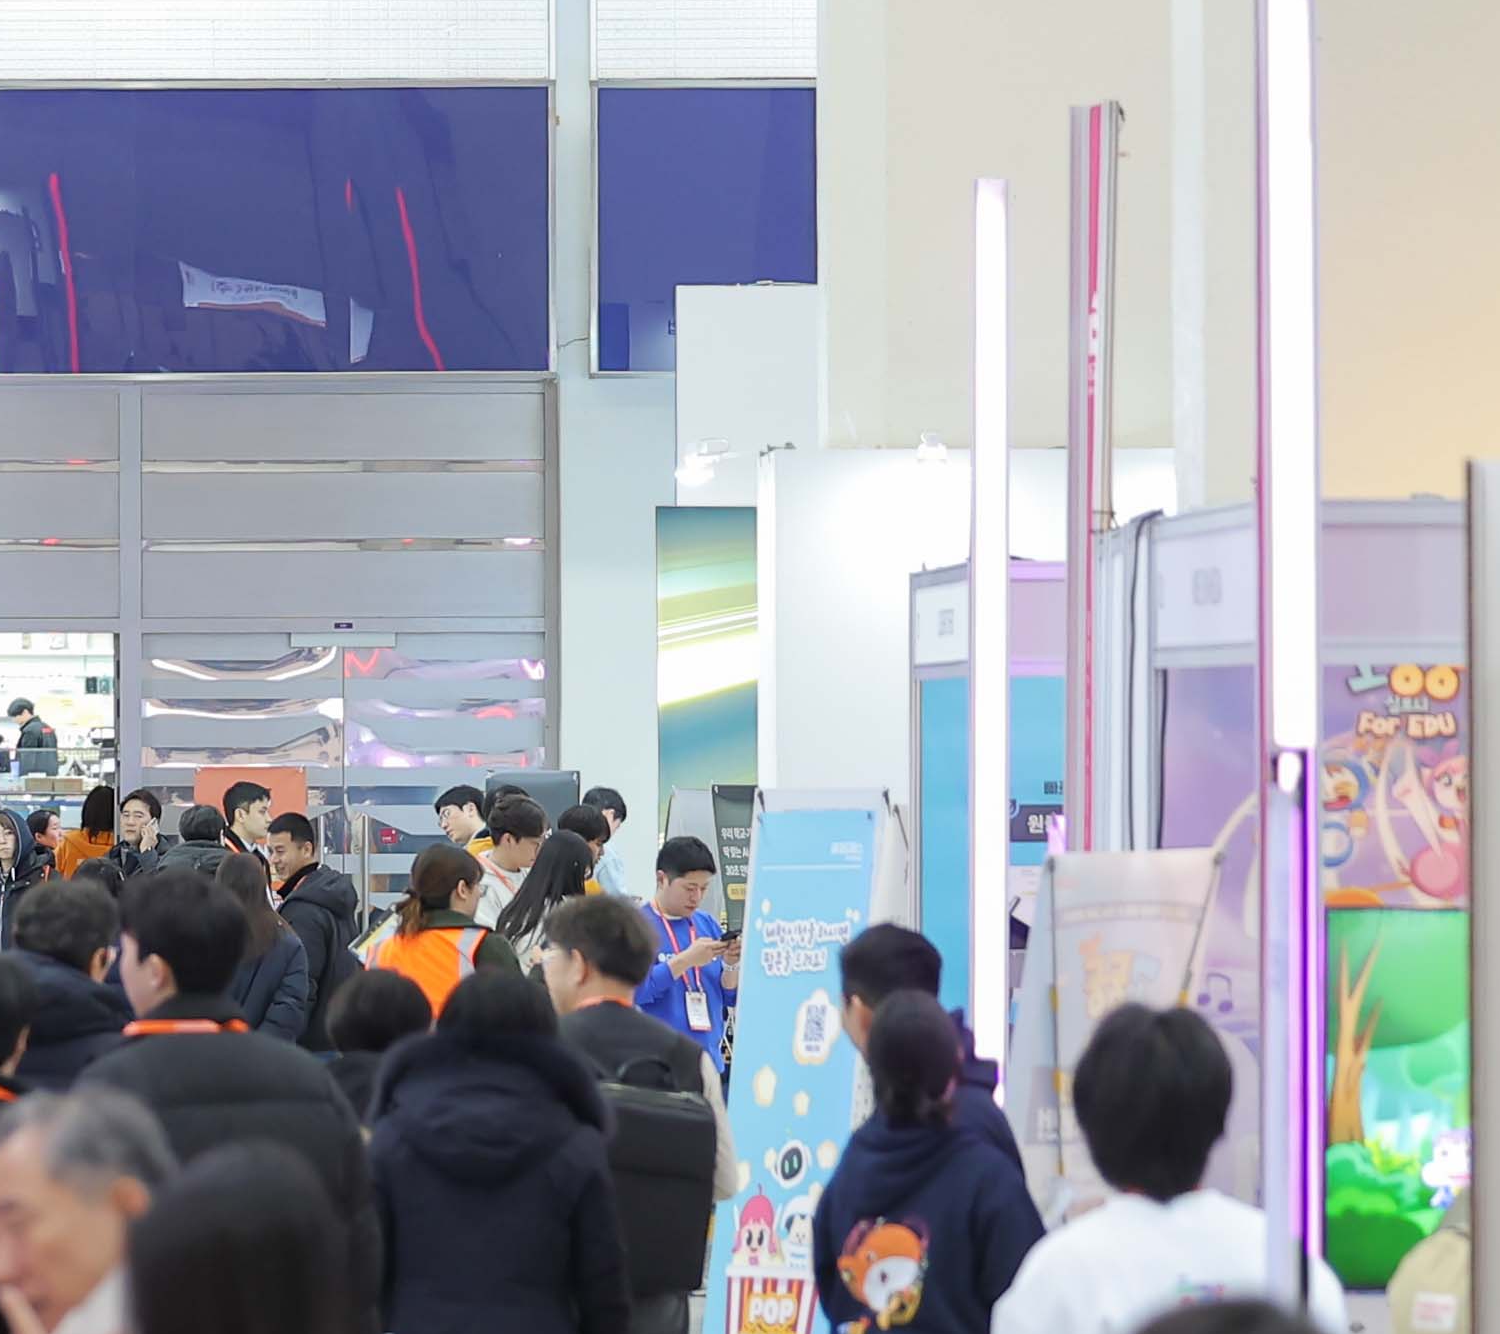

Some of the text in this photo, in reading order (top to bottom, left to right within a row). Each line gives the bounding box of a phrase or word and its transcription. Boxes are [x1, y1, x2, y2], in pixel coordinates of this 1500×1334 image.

[1357, 711, 1457, 738] For EDU
[747, 1296, 794, 1326] POP
